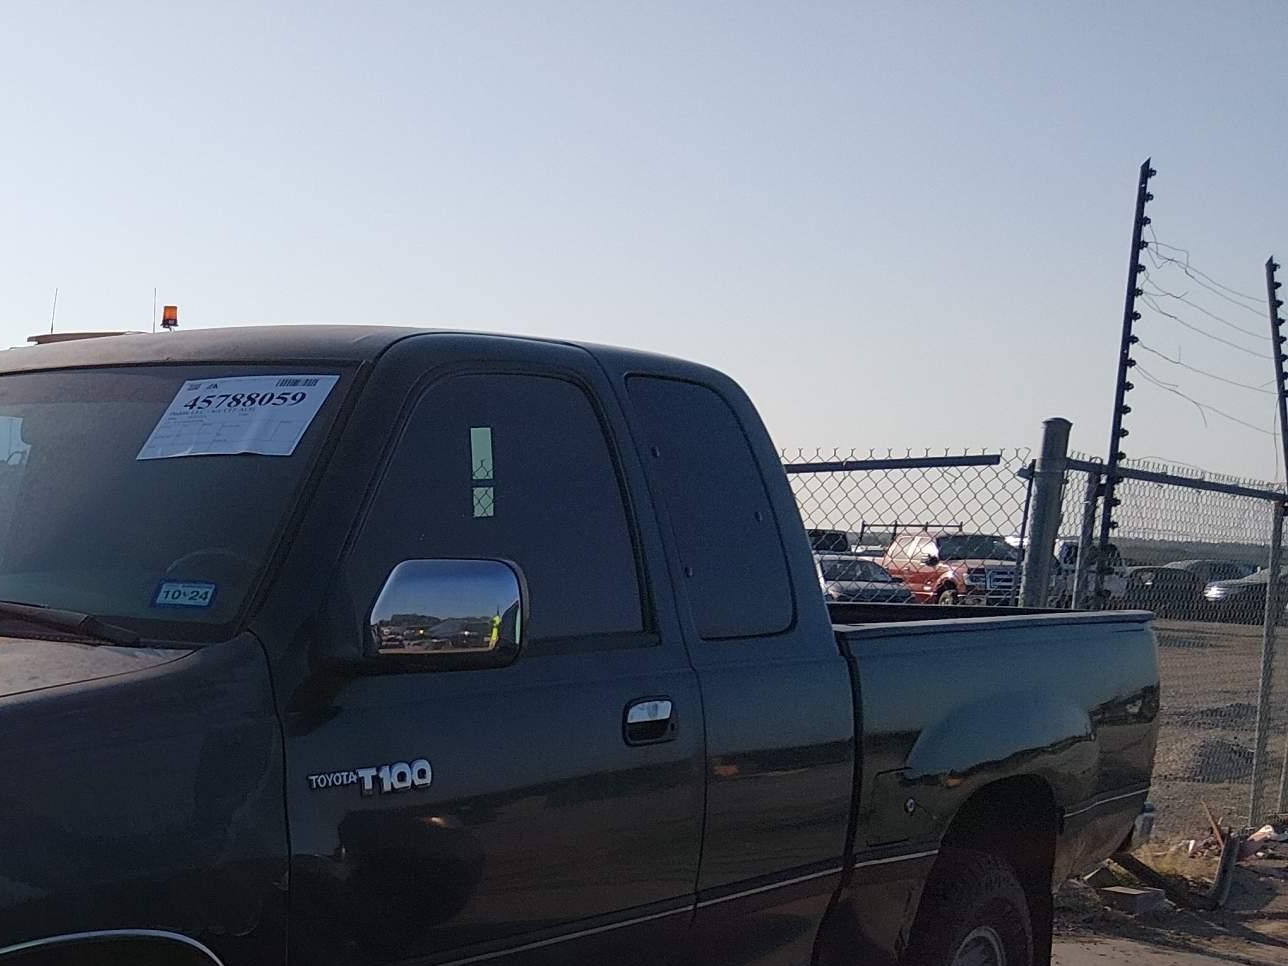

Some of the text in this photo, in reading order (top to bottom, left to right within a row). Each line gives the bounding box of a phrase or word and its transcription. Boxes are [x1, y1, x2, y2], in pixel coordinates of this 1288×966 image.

[183, 391, 307, 410] 45788059
[308, 759, 432, 792] TOYOTA T100
